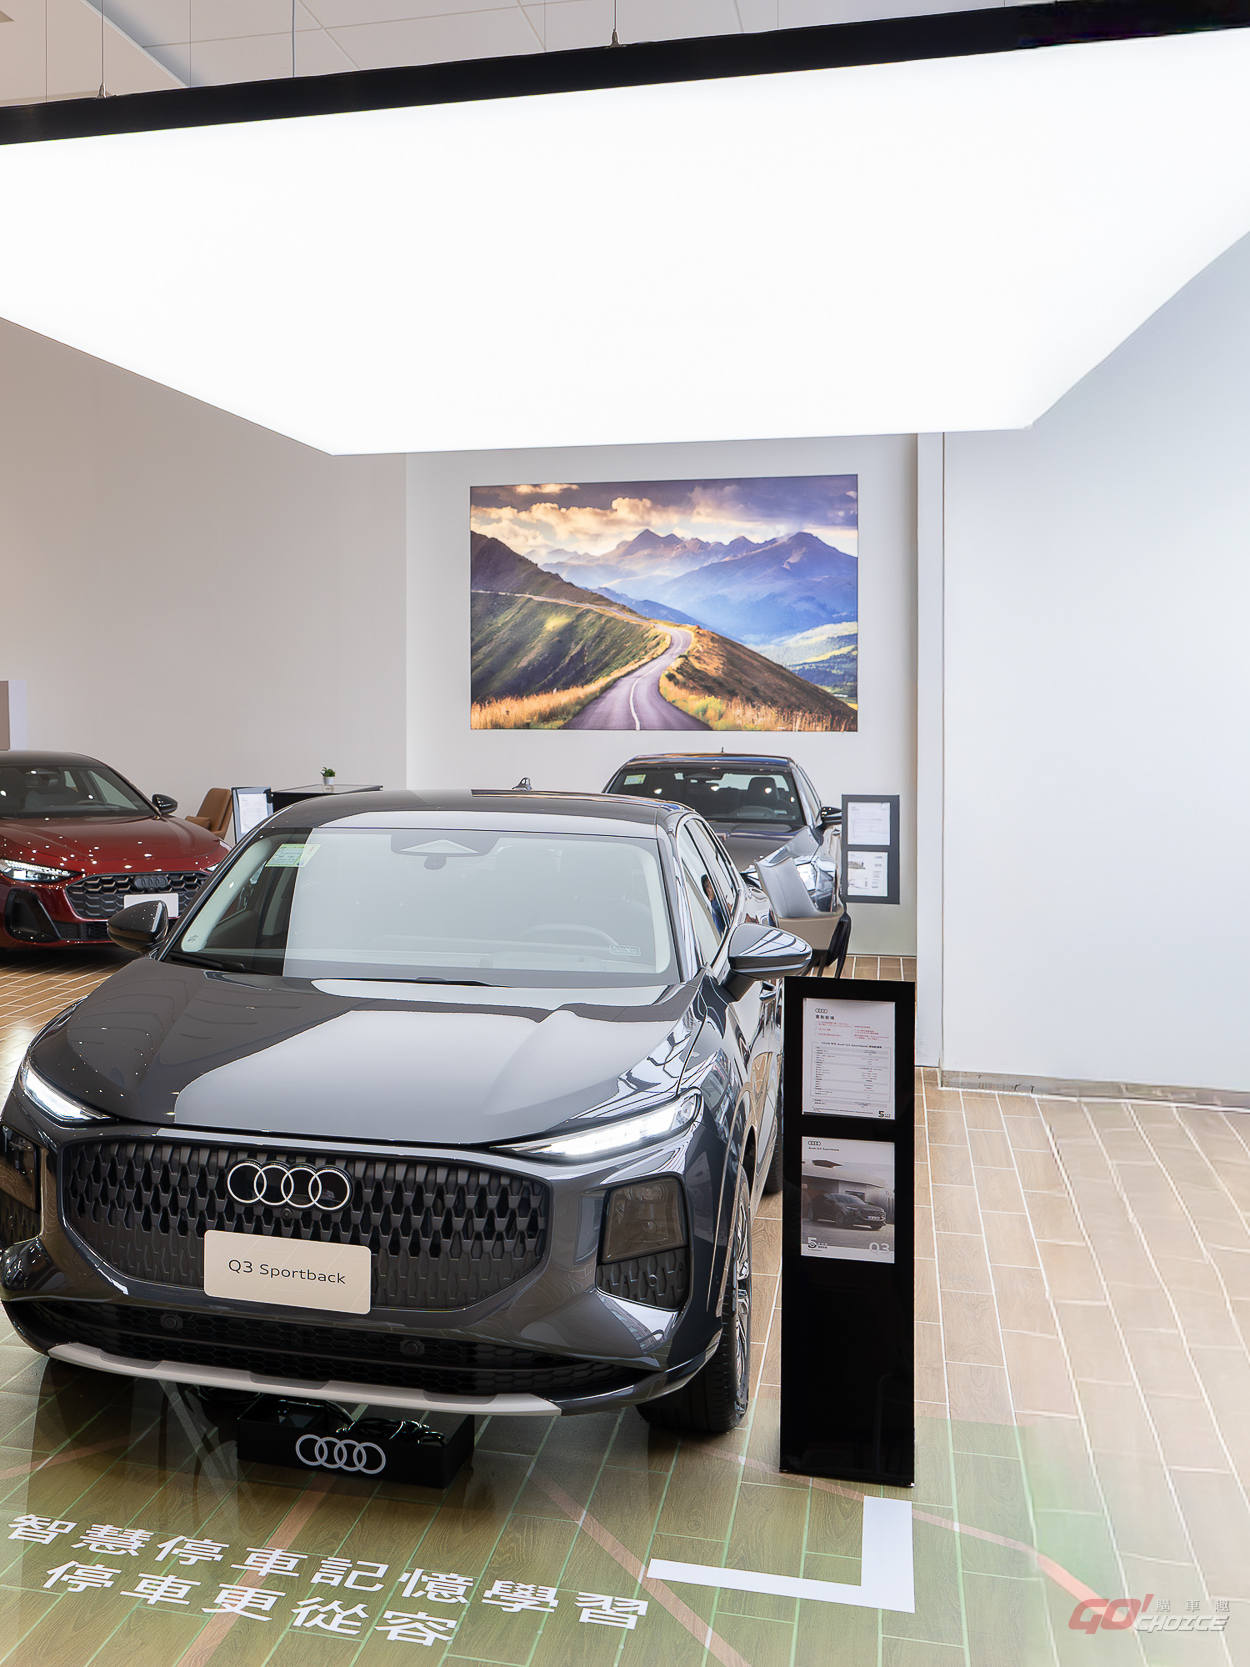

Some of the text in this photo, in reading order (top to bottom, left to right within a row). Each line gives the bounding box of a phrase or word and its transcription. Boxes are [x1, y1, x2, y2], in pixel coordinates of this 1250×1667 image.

[228, 1259, 346, 1284] Q3 Sportback
[869, 1242, 890, 1256] Q3
[8, 1514, 649, 1629] 智慧停車記憶學習
[42, 1560, 458, 1646] 停車更從容
